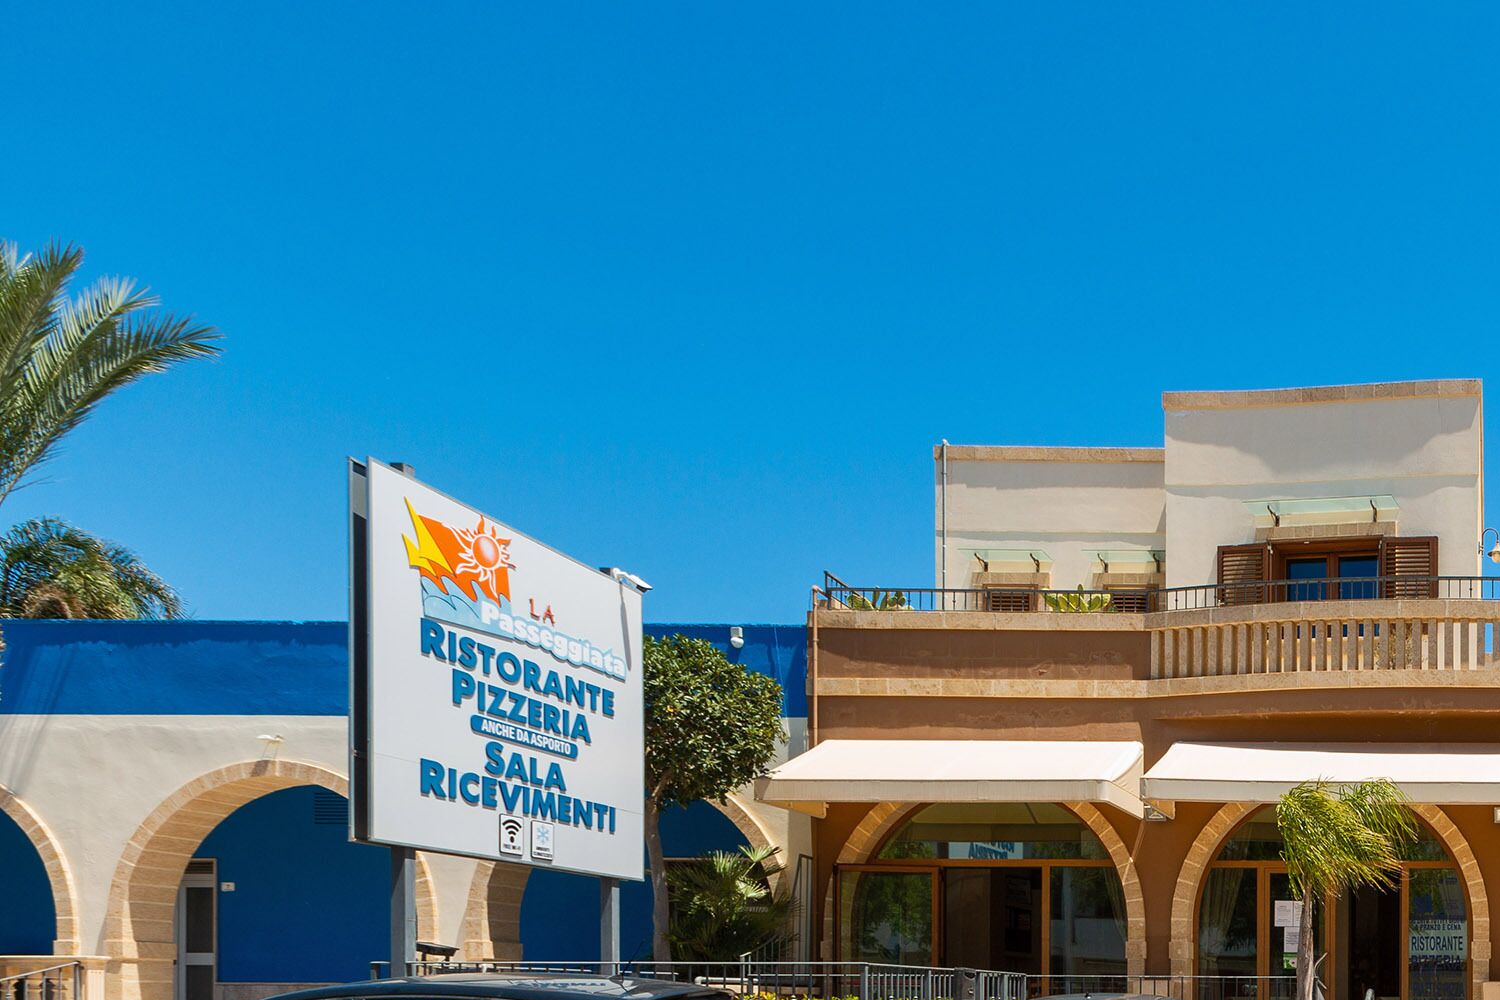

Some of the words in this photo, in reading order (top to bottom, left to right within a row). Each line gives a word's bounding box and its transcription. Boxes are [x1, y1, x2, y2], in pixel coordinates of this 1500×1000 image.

[481, 600, 627, 678] Passeggiata
[529, 598, 556, 626] LA
[420, 617, 615, 717] RISTORANTE
[452, 668, 592, 743] PIZZERIA
[481, 719, 515, 740] ANCHE
[516, 728, 530, 743] DA
[530, 732, 571, 755] ASPORTO
[420, 758, 616, 835] RICEVIMENTI
[484, 741, 567, 794] SALA
[1411, 936, 1464, 951] RISTORANTE
